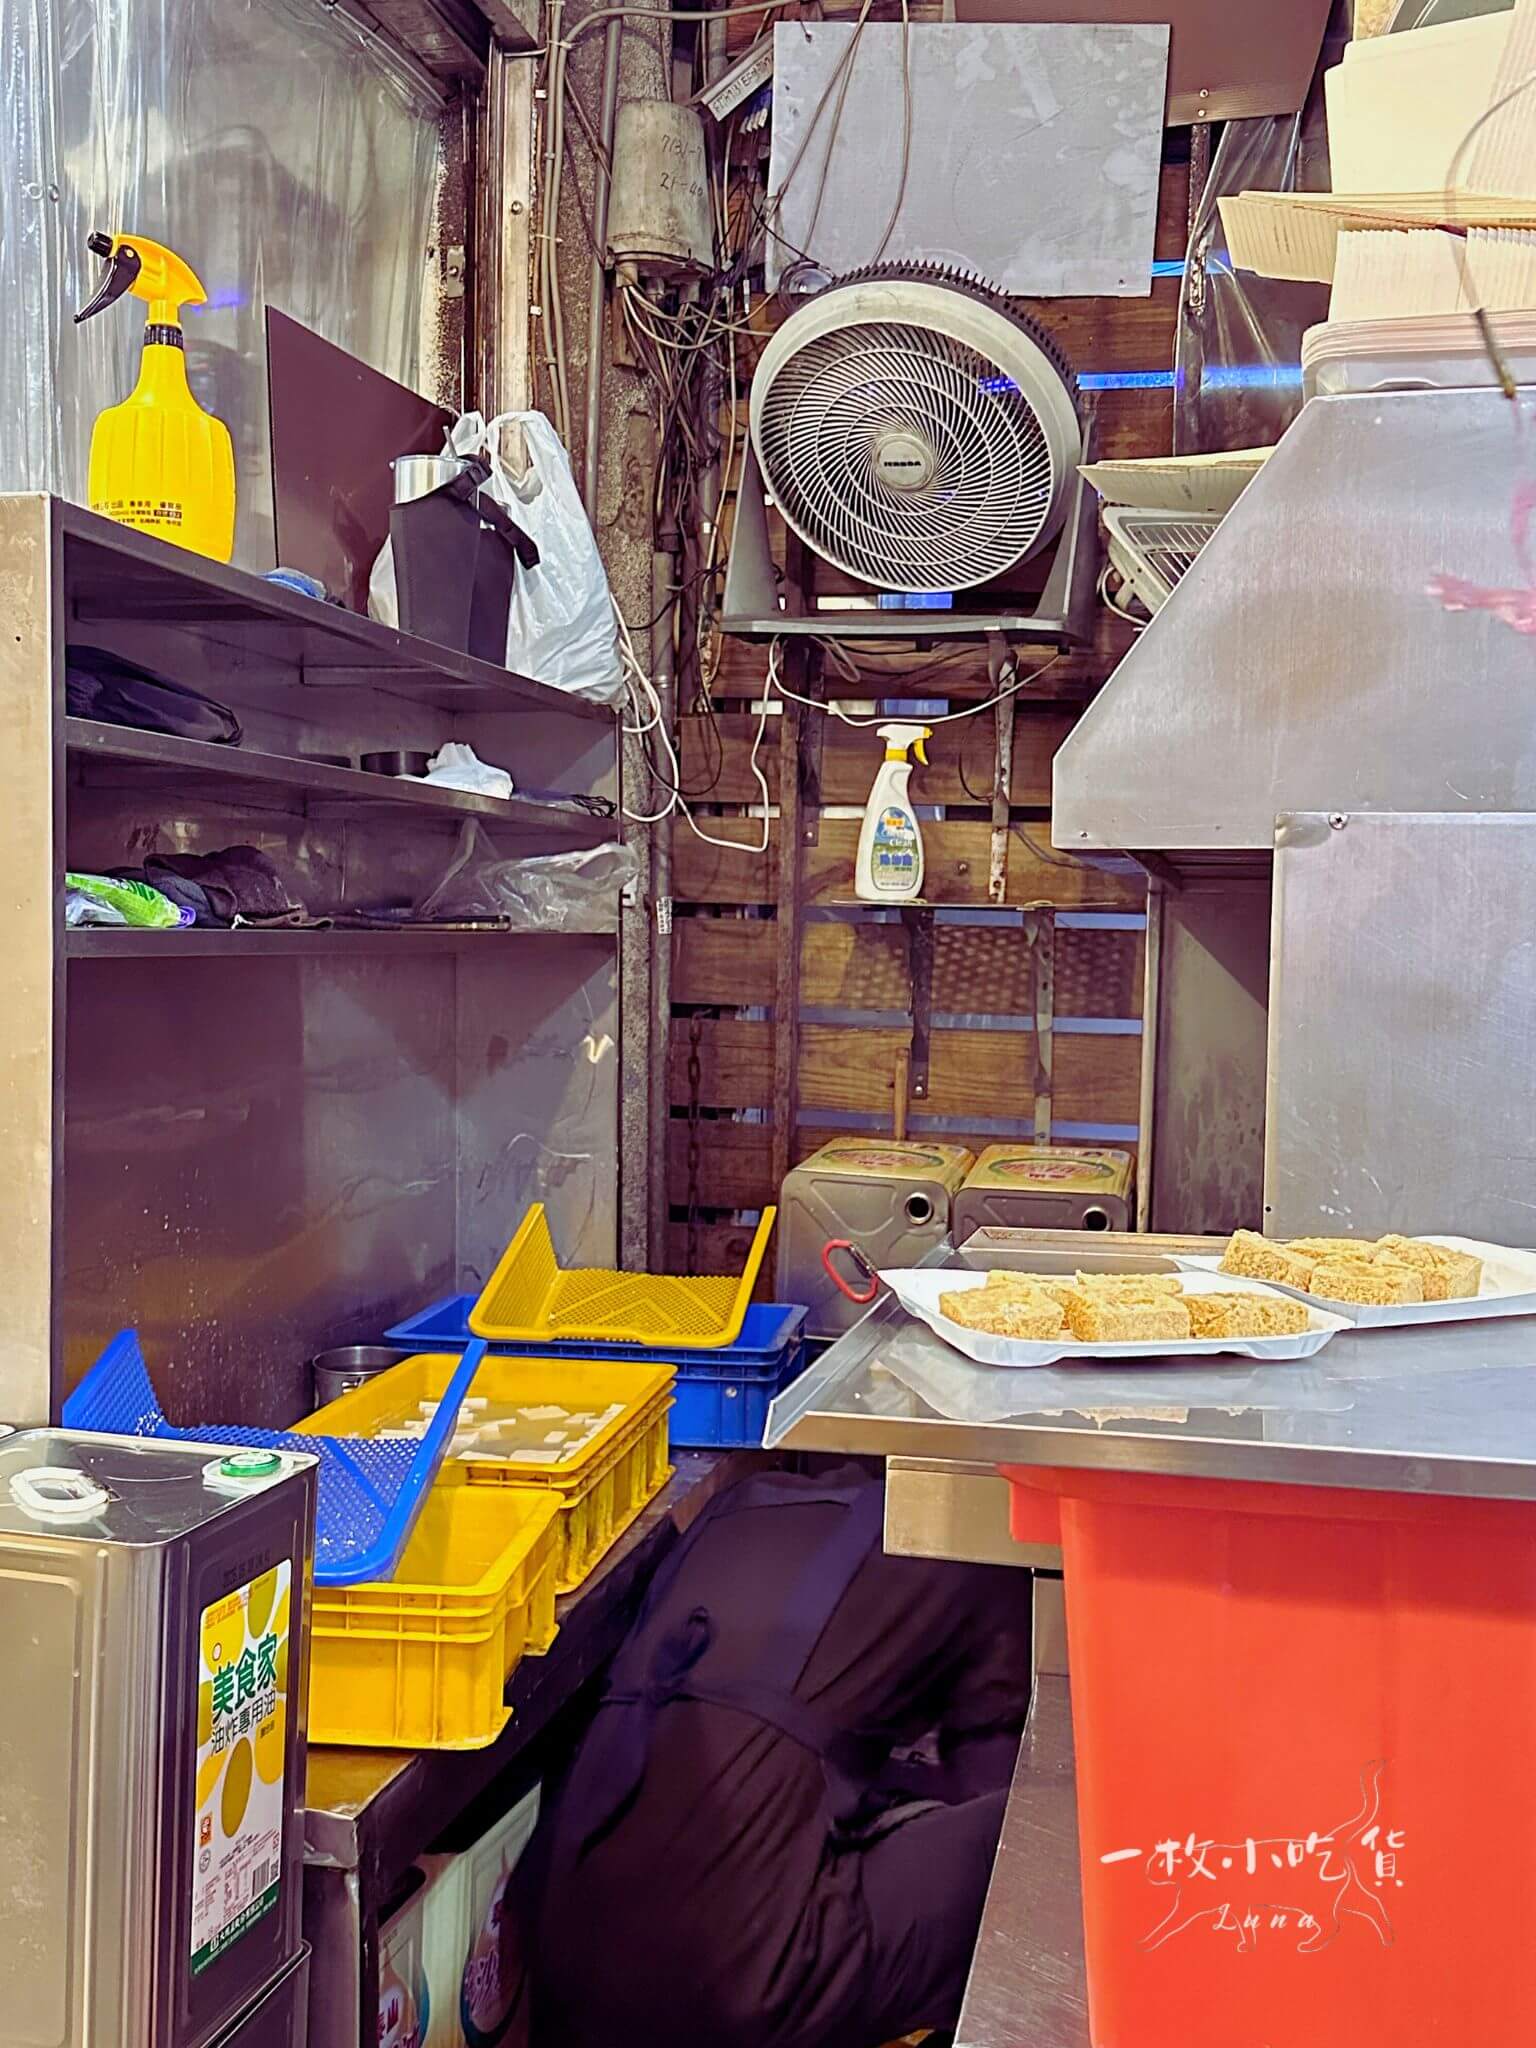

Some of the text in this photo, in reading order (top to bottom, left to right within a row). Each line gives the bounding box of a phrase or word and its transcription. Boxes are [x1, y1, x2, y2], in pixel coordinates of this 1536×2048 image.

[212, 1633, 278, 1725] 美食家
[211, 1689, 277, 1756] 油炸專用油
